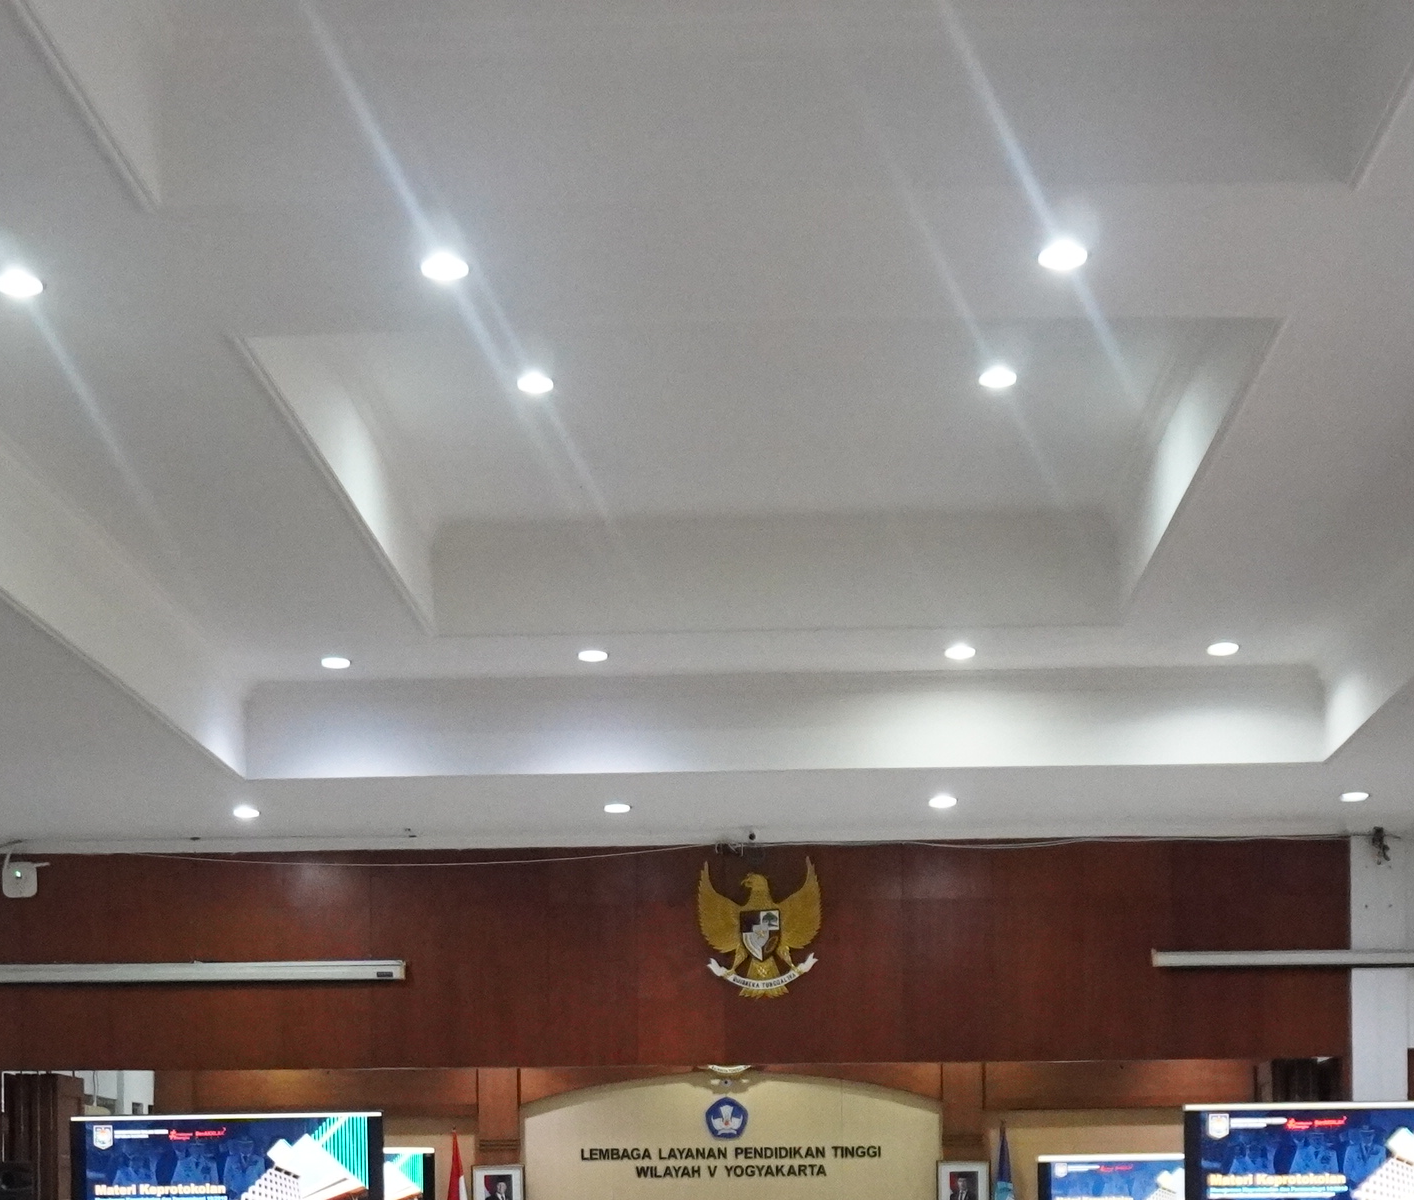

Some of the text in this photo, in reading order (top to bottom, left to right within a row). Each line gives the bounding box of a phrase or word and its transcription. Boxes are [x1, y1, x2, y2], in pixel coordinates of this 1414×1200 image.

[580, 1145, 882, 1161] LEMBAGA LAYANAN PENDIDIKAN TINGGI
[635, 1164, 827, 1178] WILAYAH V YOGYAKARTA
[1208, 1173, 1347, 1187] Materi Keprotokolan
[94, 1183, 227, 1197] Materi Keprotokolan
